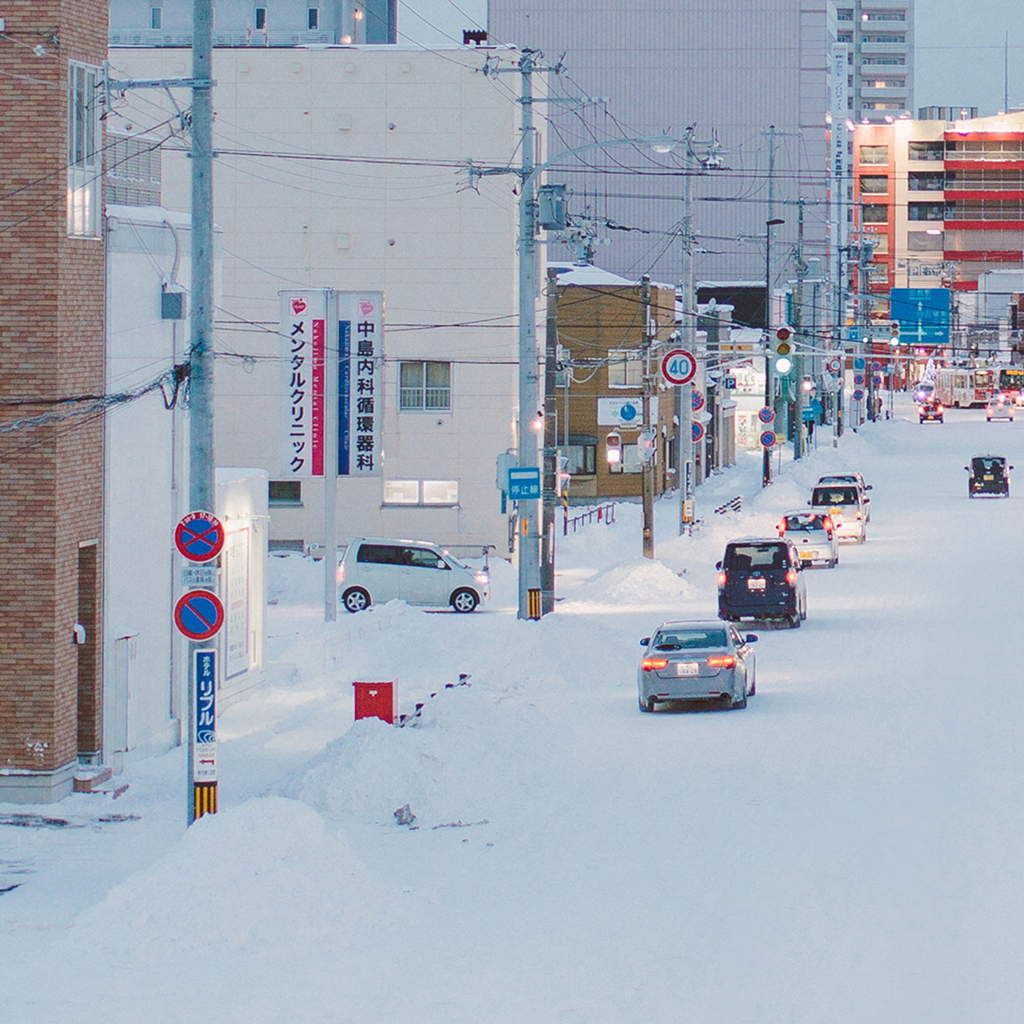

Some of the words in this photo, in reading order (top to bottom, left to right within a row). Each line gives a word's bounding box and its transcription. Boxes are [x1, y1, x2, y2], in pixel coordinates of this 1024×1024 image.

[312, 322, 320, 370] Nakajima
[669, 359, 689, 375] 40
[727, 379, 735, 388] P
[290, 321, 306, 473] メンタルクリニック
[312, 376, 320, 411] Mental
[356, 320, 375, 471] 中島内科循環器科
[312, 416, 320, 449] Clinic
